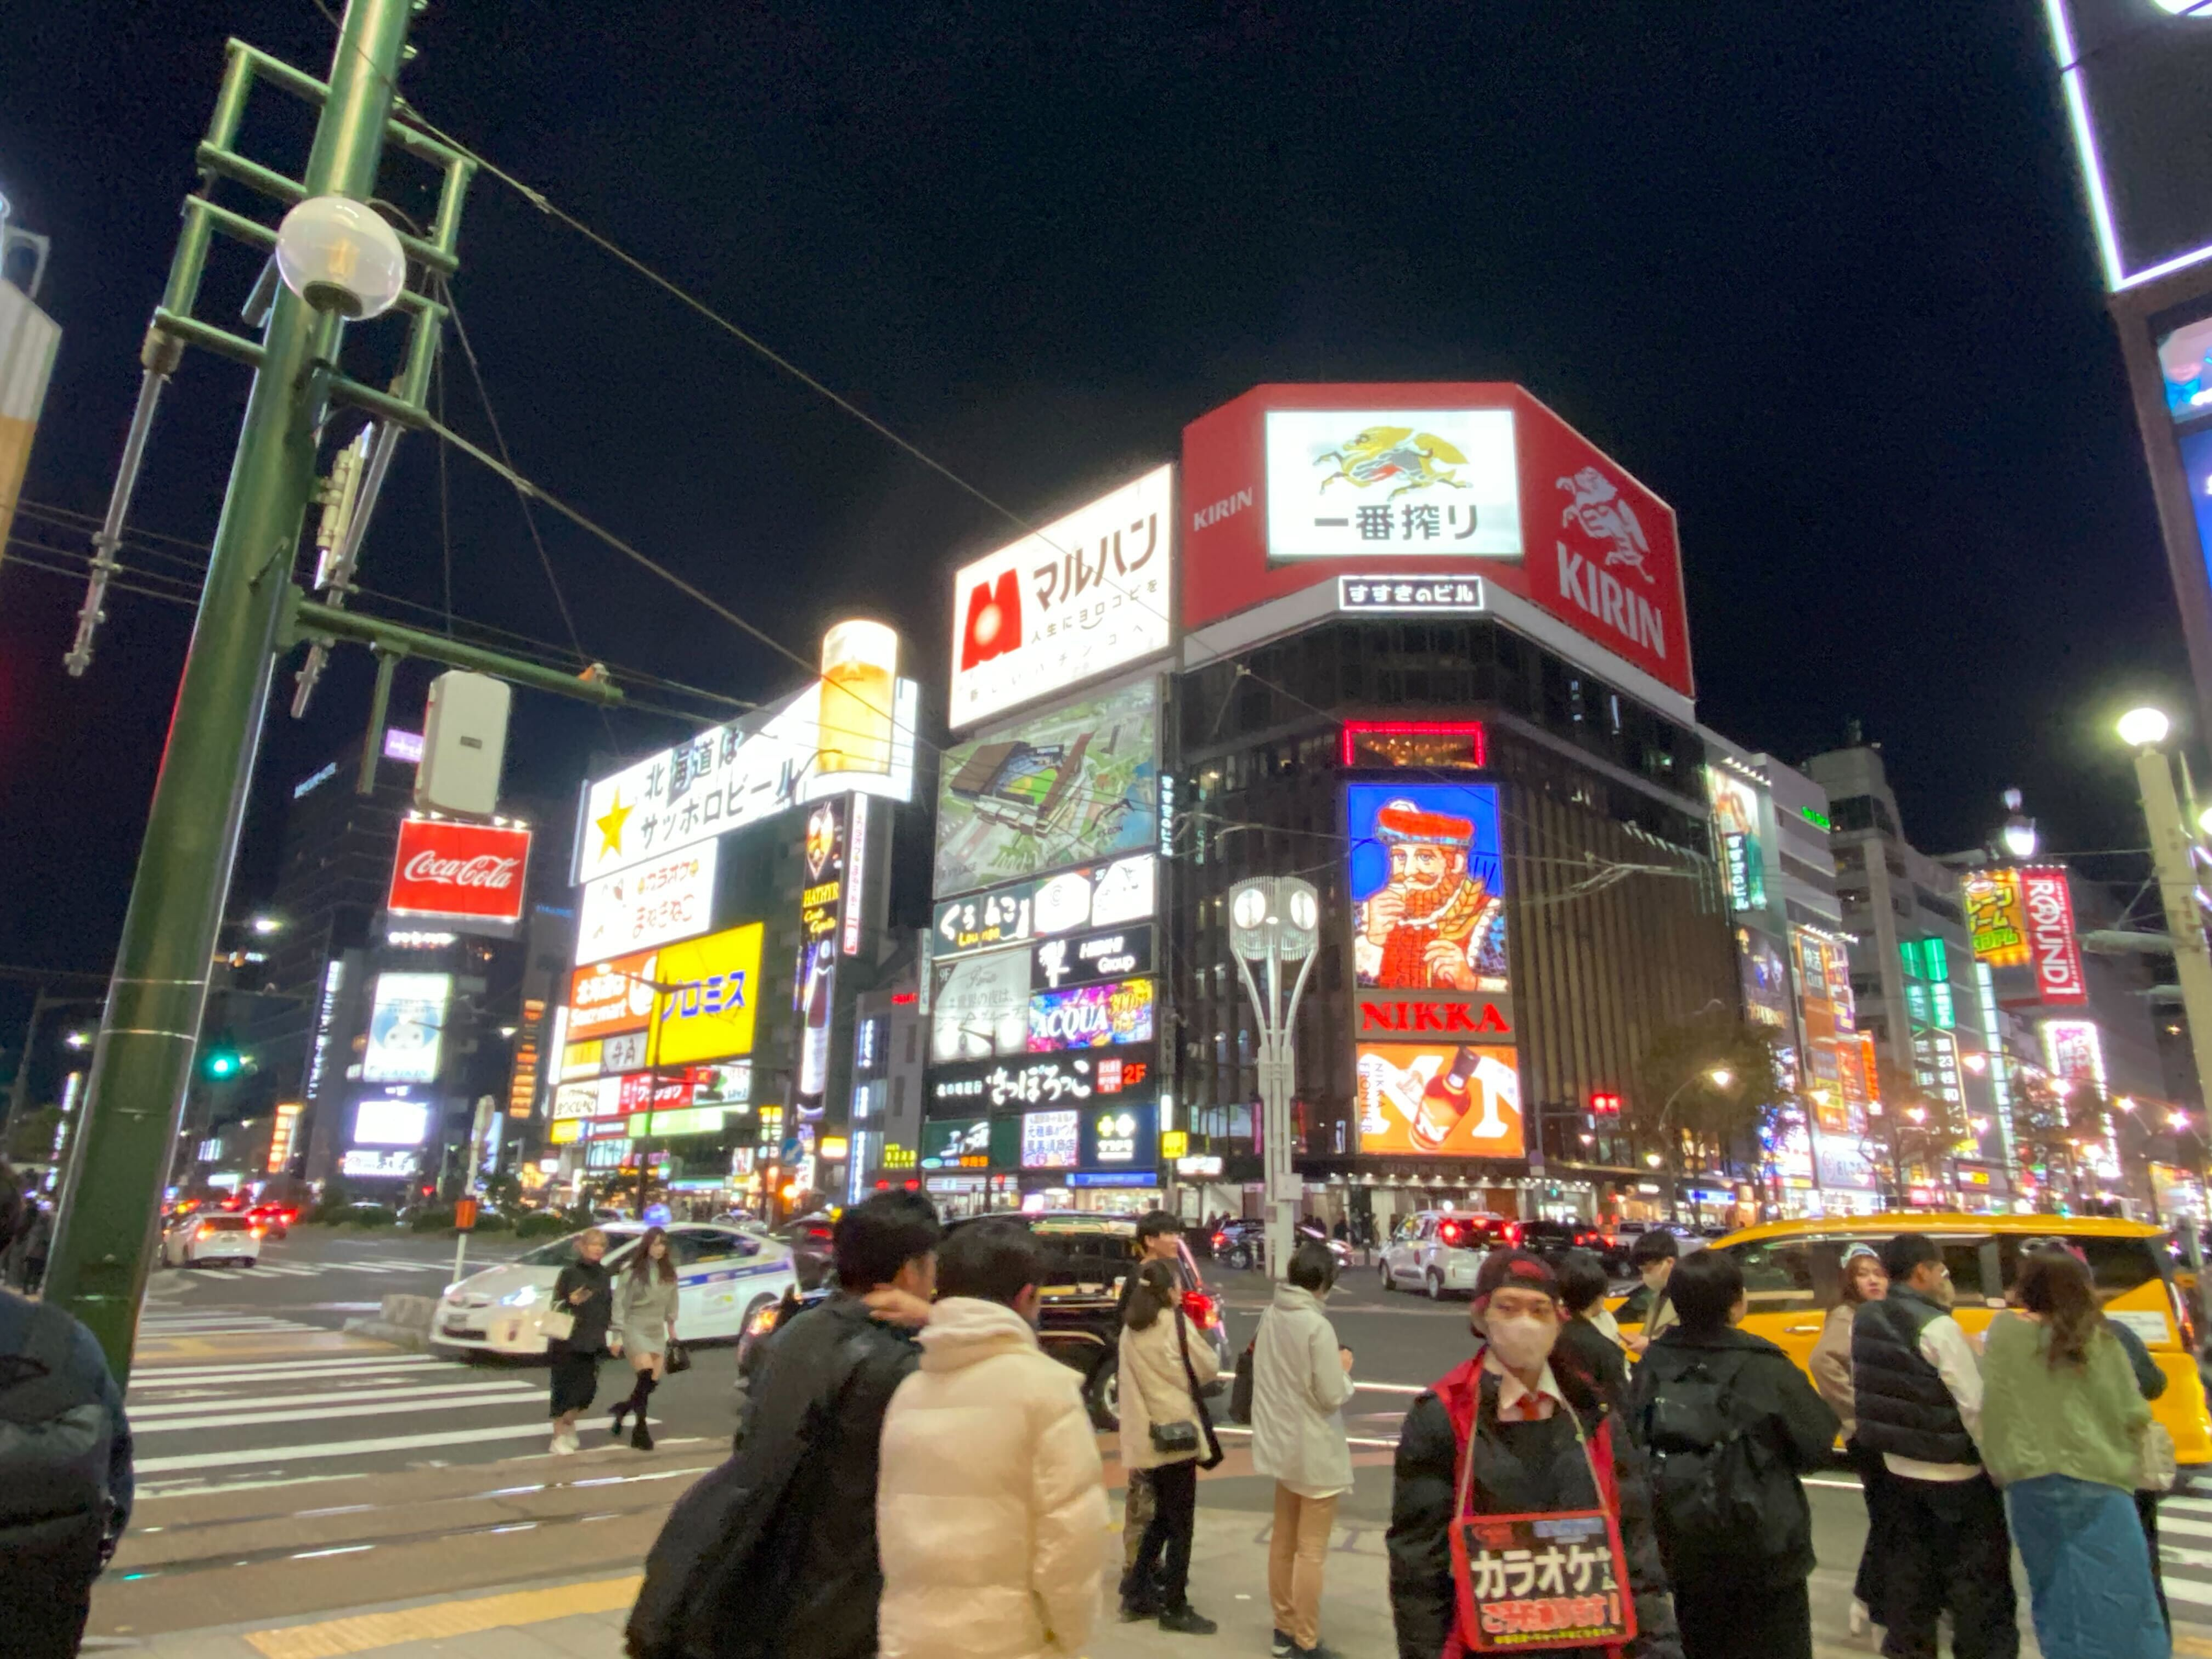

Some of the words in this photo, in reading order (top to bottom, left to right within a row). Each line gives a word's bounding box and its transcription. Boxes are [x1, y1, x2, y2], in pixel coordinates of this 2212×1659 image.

[1193, 487, 1253, 531] KIRIN
[1313, 502, 1478, 542] 一番搾り
[1033, 512, 1158, 612] マルハン
[1031, 579, 1158, 645] 人生にヨロコビを
[1349, 583, 1474, 606] すすきのビル
[1555, 540, 1666, 660] KIRIN
[643, 726, 743, 801] 北海道は
[640, 758, 798, 850] サッポロビール
[404, 849, 521, 890] Coca-Cola
[1029, 1004, 1109, 1040] ACQUA
[1360, 1001, 1512, 1033] NIKKA
[1123, 1063, 1147, 1085] 2F
[1375, 1062, 1386, 1108] NIKKA
[1358, 1062, 1373, 1134] FRONTIER
[1471, 1545, 1596, 1599] カラオケ
